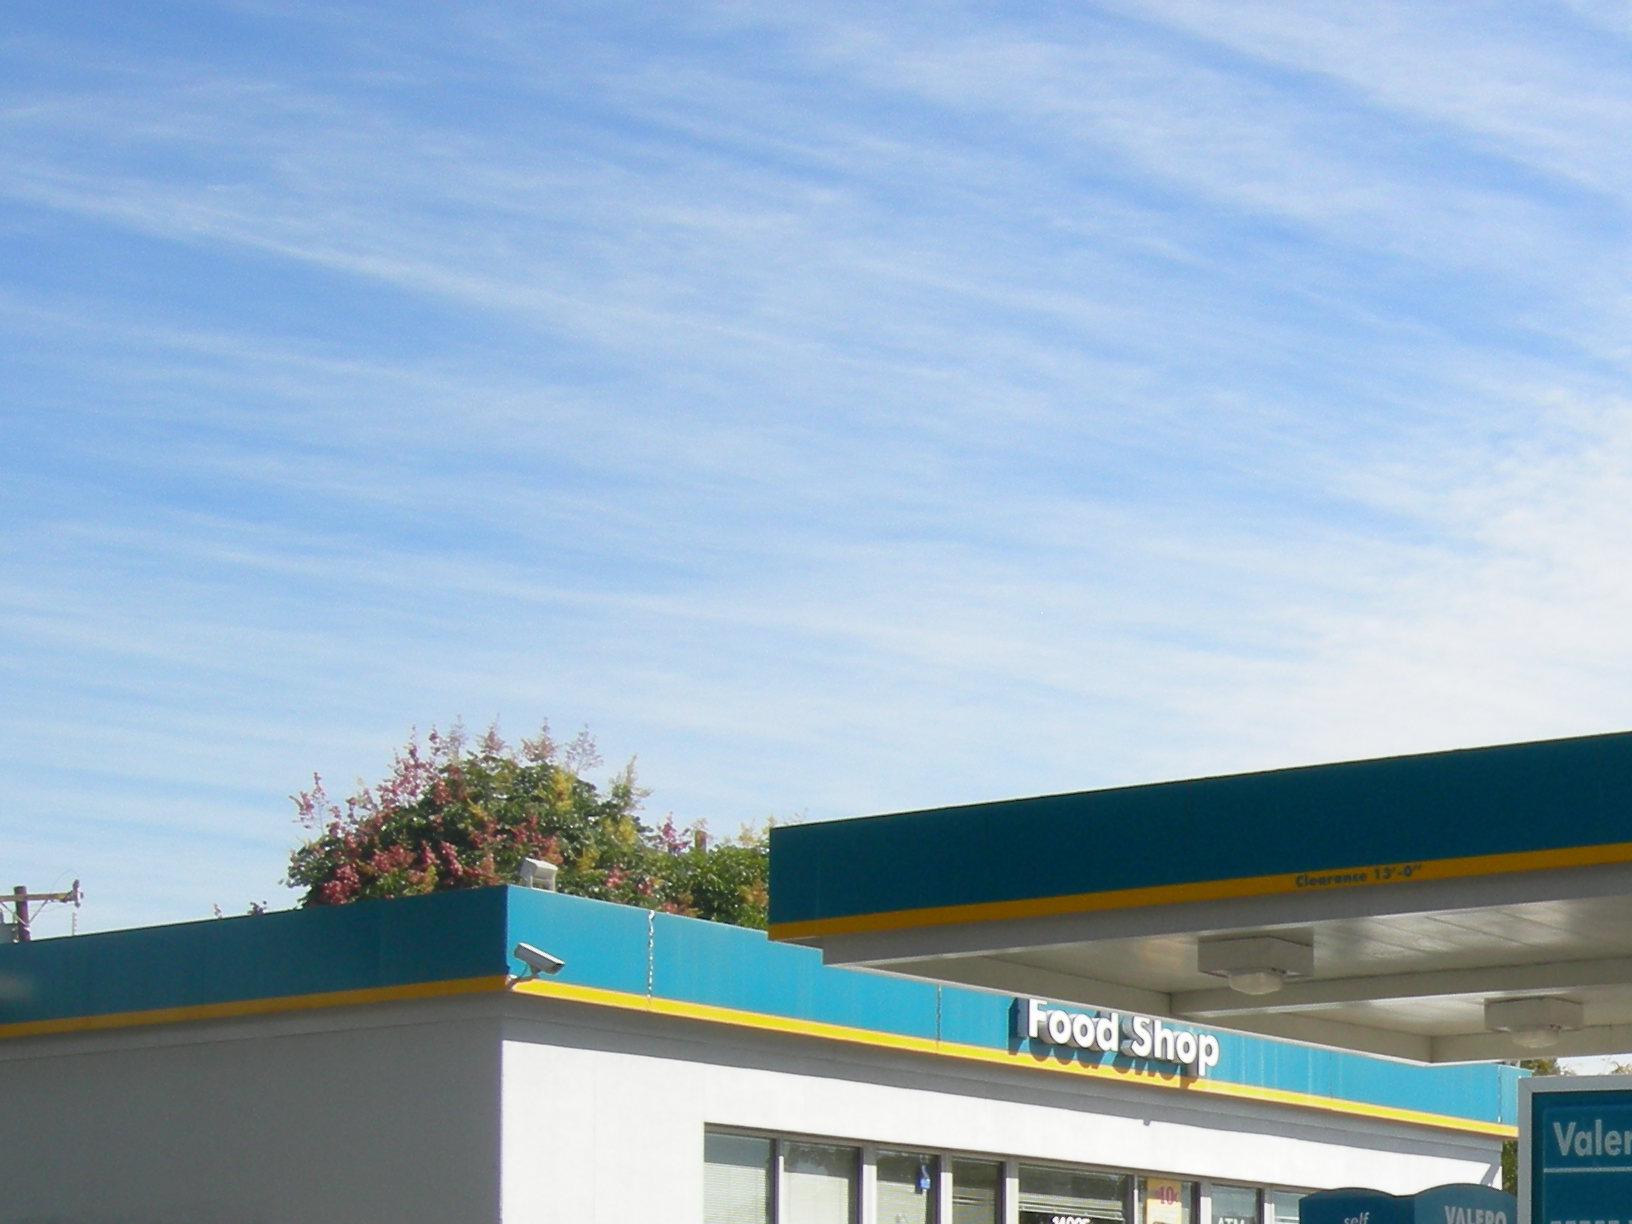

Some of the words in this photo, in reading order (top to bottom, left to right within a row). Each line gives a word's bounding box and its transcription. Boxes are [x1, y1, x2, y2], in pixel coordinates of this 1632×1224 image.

[1295, 872, 1367, 887] Clearance
[1027, 998, 1119, 1052] Food
[1131, 1015, 1220, 1076] Shop
